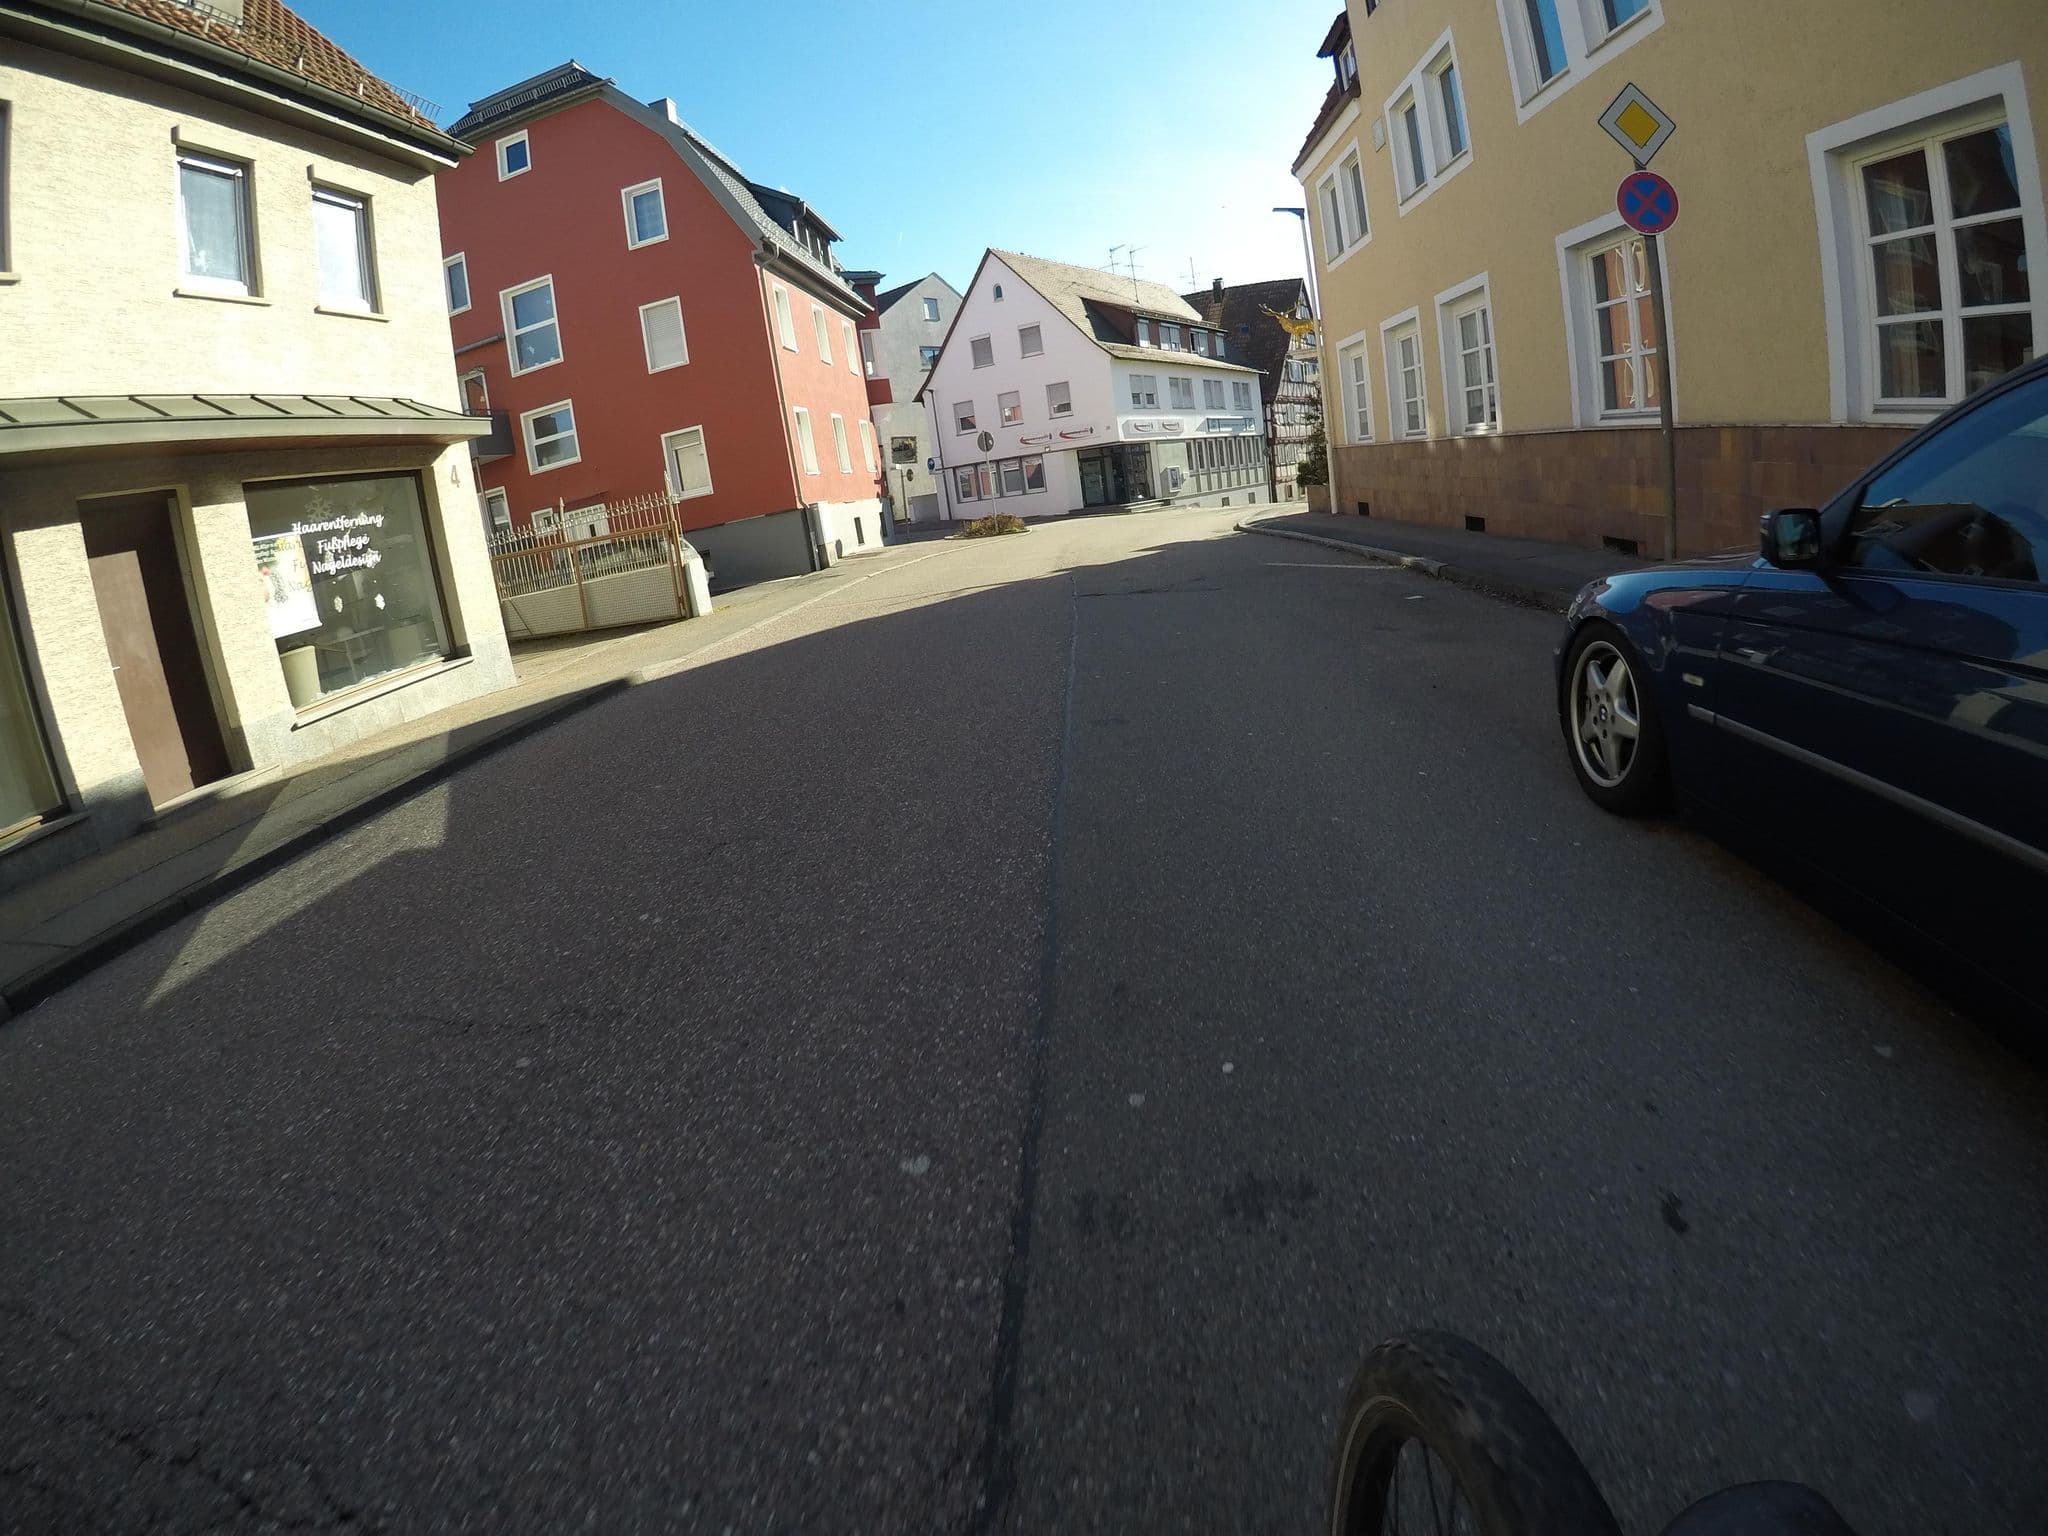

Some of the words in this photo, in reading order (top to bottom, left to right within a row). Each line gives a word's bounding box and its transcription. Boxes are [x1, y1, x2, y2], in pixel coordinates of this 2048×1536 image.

[451, 465, 461, 488] 4
[291, 513, 385, 534] Haarentfernung
[316, 534, 371, 554] Fußpflege
[311, 551, 382, 575] Nageldesign
